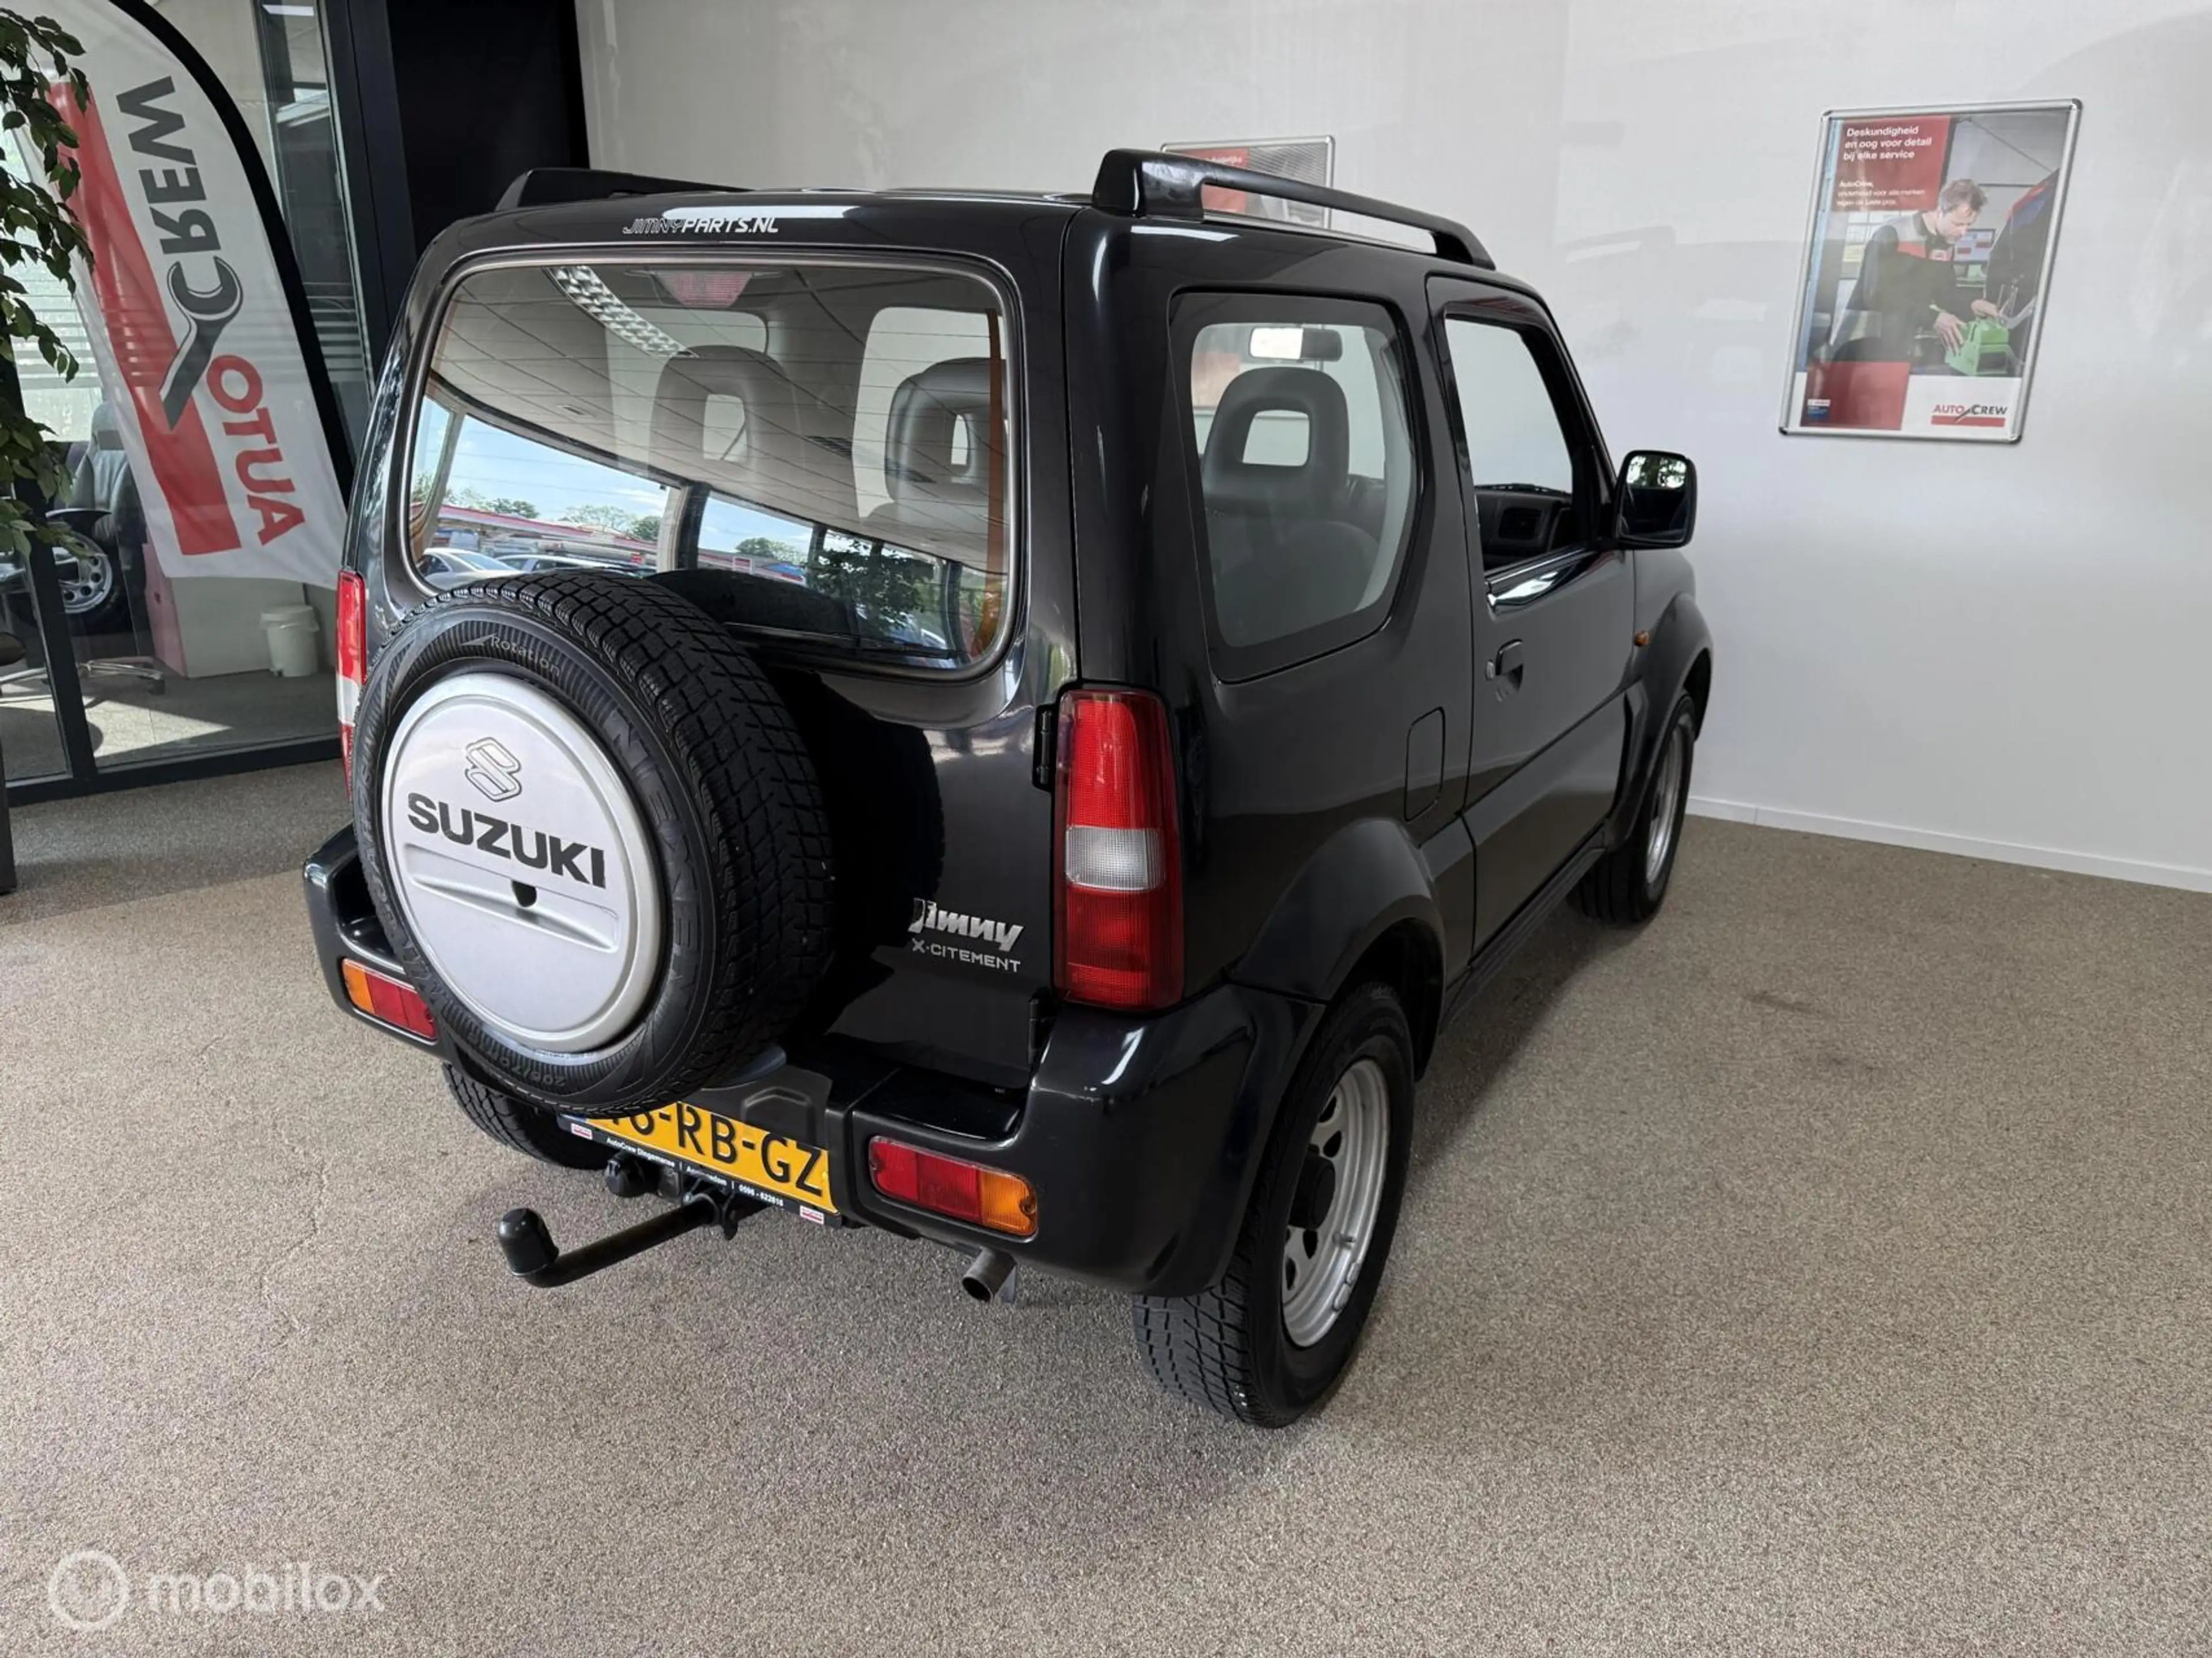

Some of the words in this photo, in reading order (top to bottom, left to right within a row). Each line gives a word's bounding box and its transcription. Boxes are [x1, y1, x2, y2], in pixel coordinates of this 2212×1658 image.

[1846, 125, 1919, 136] Deskundigheid
[1859, 141, 1878, 150] oog
[1880, 139, 1903, 147] voor
[1904, 136, 1932, 146] detail
[1843, 152, 1855, 162] bij
[1857, 151, 1877, 160] elke
[1879, 150, 1915, 159] service
[1931, 404, 1965, 414] AUTO
[490, 635, 560, 677] Rotation
[407, 791, 608, 890] SUZUKI
